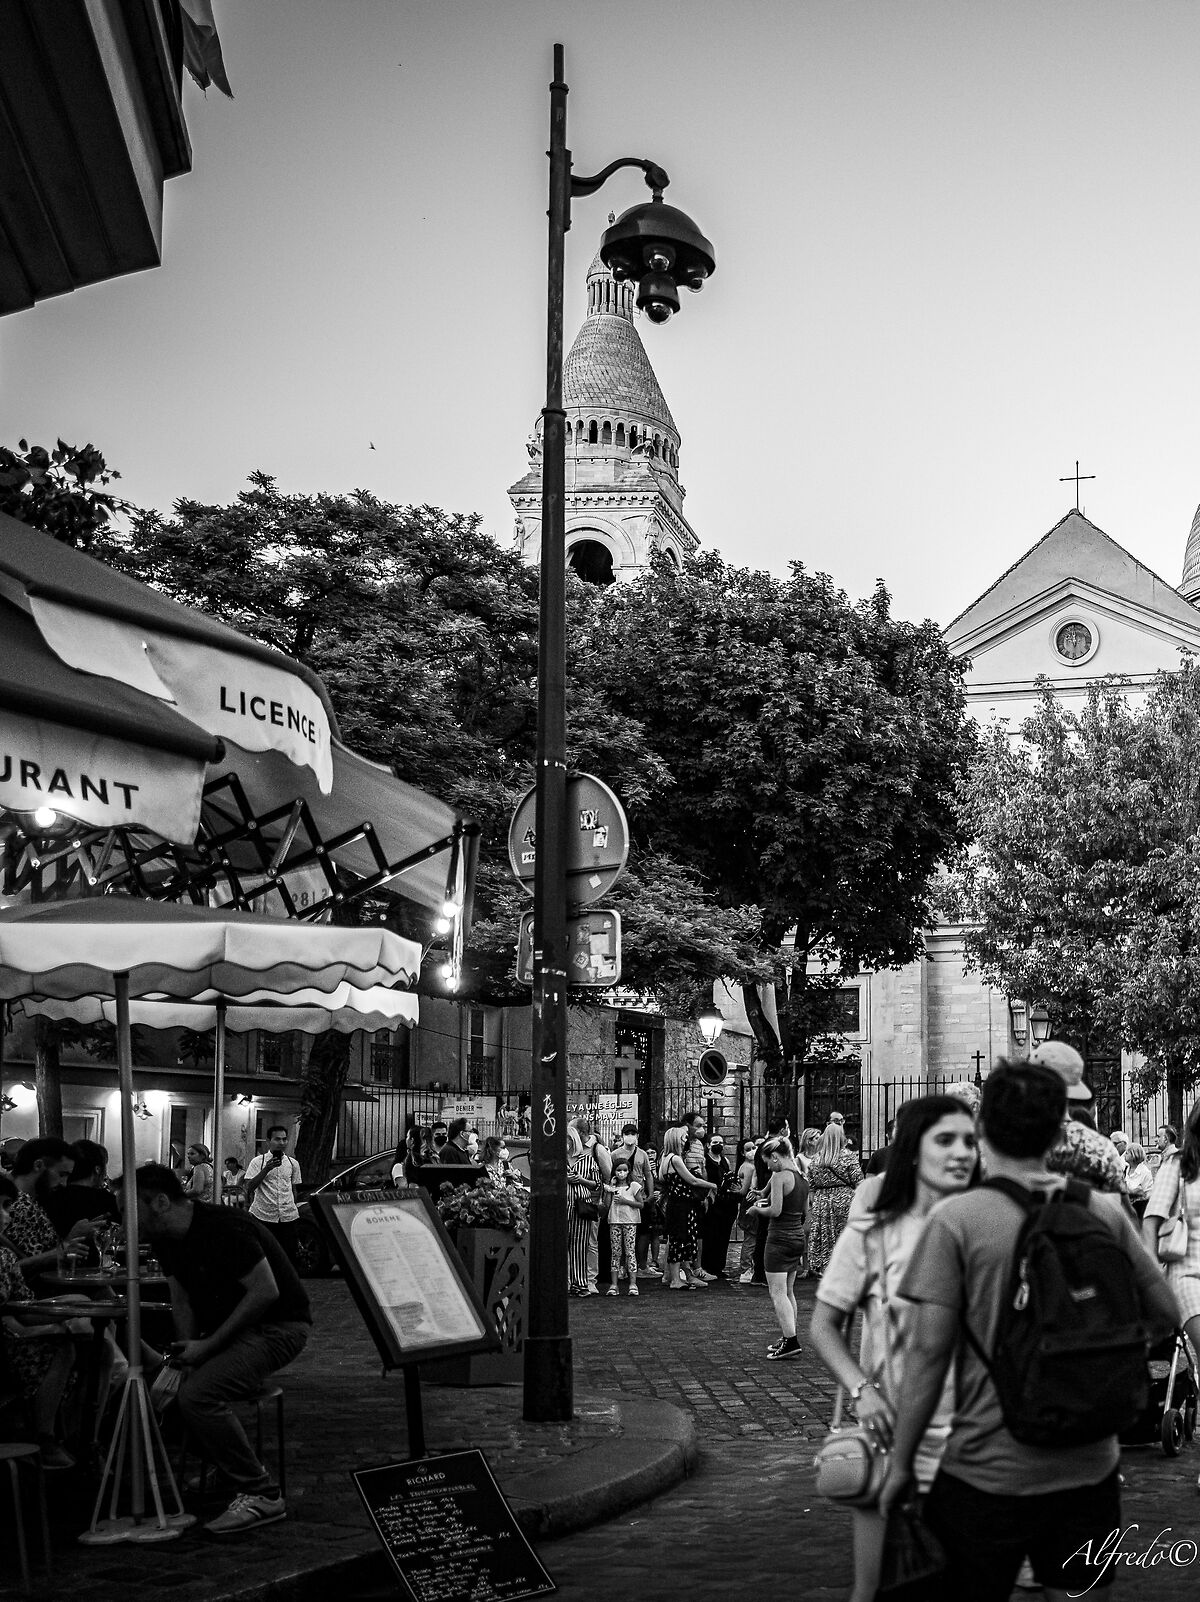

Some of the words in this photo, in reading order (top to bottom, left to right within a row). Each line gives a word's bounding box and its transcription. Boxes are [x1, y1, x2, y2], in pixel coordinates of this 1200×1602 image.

[219, 686, 316, 744] LICENCE
[585, 1102, 603, 1111] UNE
[406, 1472, 446, 1486] RICHARD
